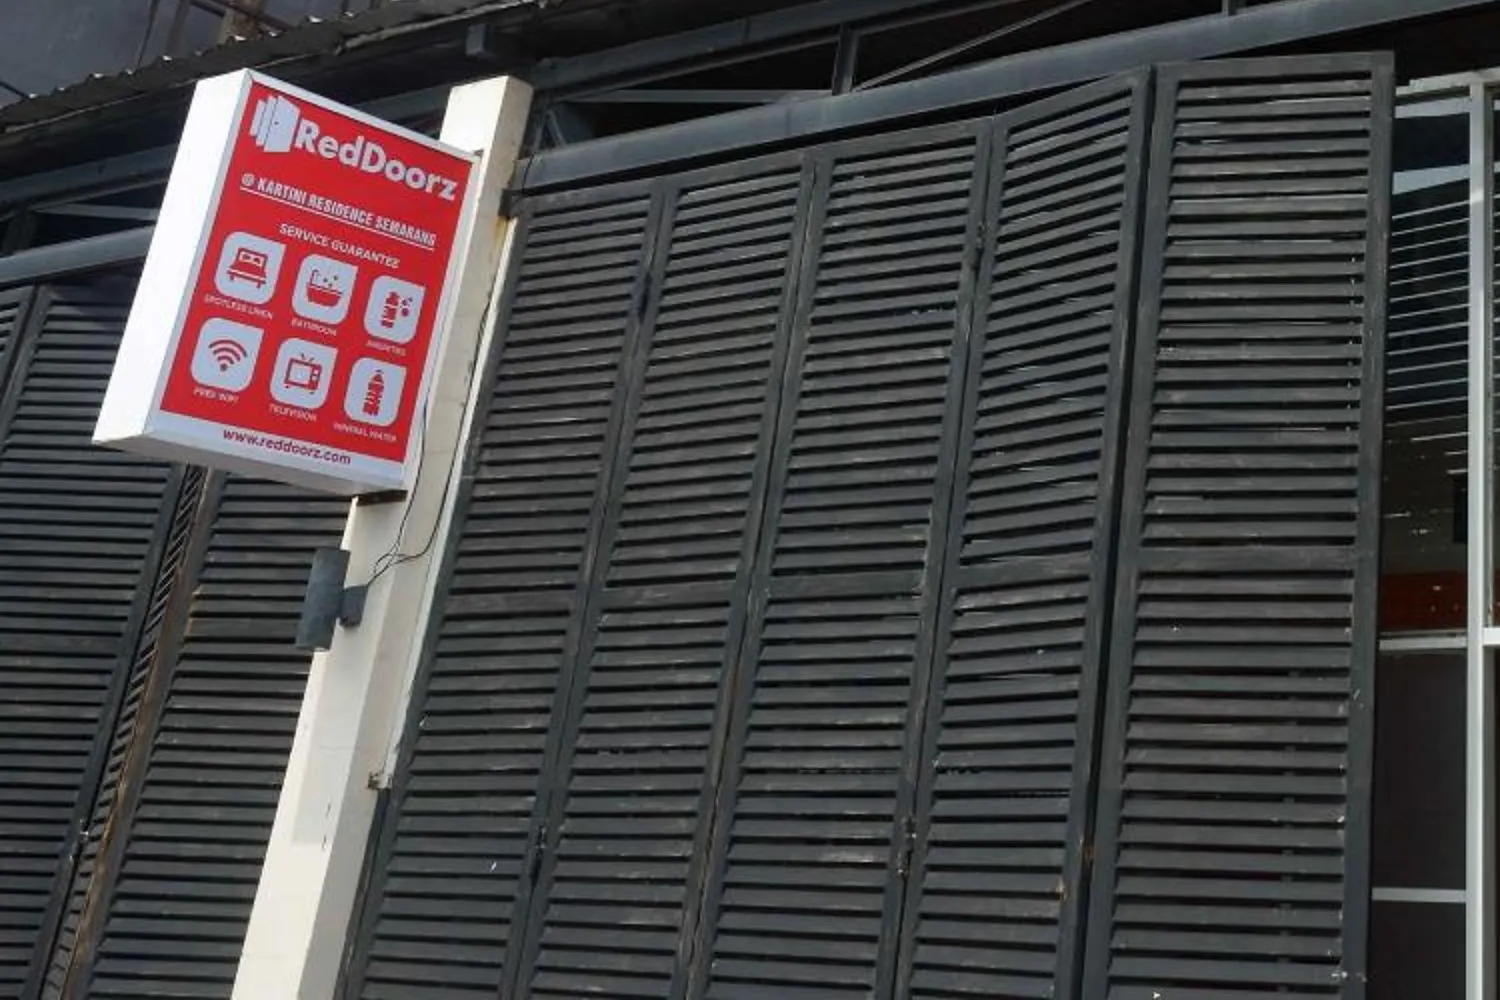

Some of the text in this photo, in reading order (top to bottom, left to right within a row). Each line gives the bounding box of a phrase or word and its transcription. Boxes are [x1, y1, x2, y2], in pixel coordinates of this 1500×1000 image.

[293, 116, 460, 201] RedDoorz
[256, 177, 307, 204] KARTINI
[307, 194, 375, 226] RESIDENCE
[374, 215, 438, 247] SEMARANG
[278, 222, 401, 269] SERVICE GUARANTEE
[222, 429, 352, 465] www.reddoorz.com
